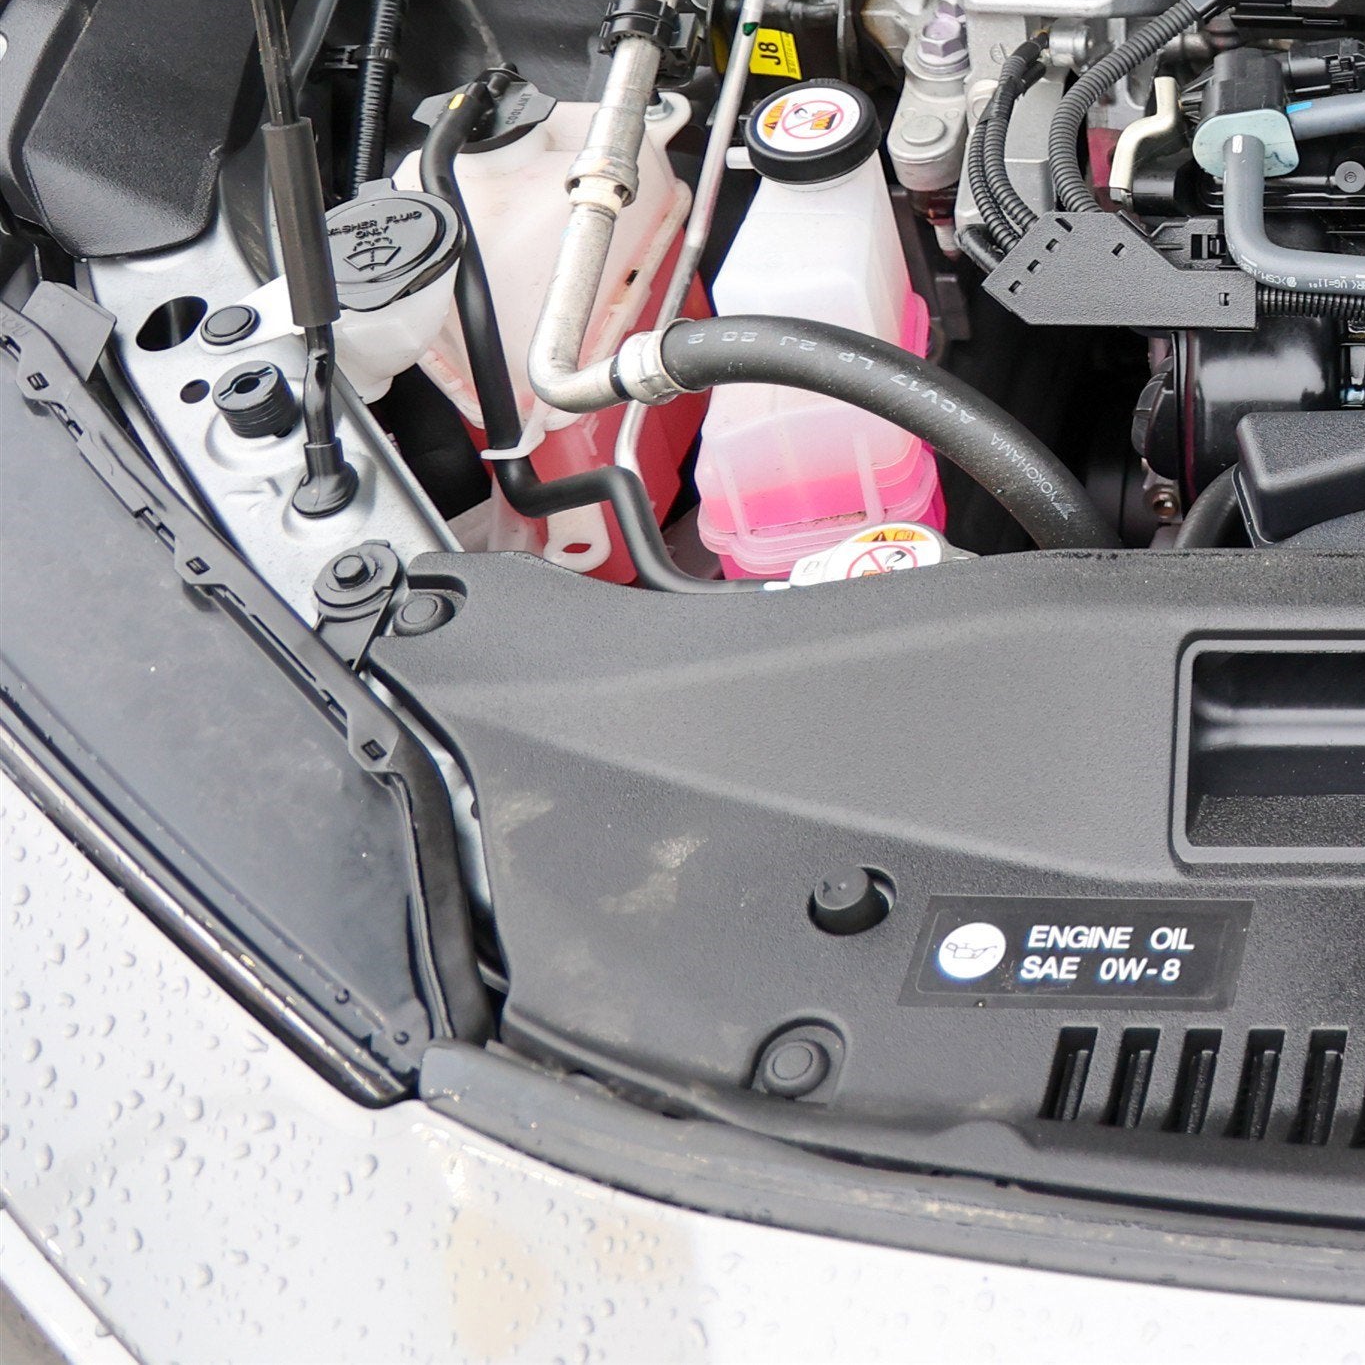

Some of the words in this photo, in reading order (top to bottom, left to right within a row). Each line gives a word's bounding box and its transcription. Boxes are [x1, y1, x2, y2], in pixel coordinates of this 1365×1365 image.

[757, 41, 781, 66] J8
[504, 92, 533, 125] COOLANT
[385, 210, 422, 225] FLUID
[354, 225, 390, 239] ONLY
[837, 350, 877, 371] LP
[889, 373, 976, 425] ACV17
[991, 432, 1058, 505] YOKOHAMA
[1027, 925, 1134, 950] ENGINE
[1150, 926, 1196, 951] OIL
[1020, 956, 1080, 980] SAE
[1099, 956, 1182, 982] 0W-8
